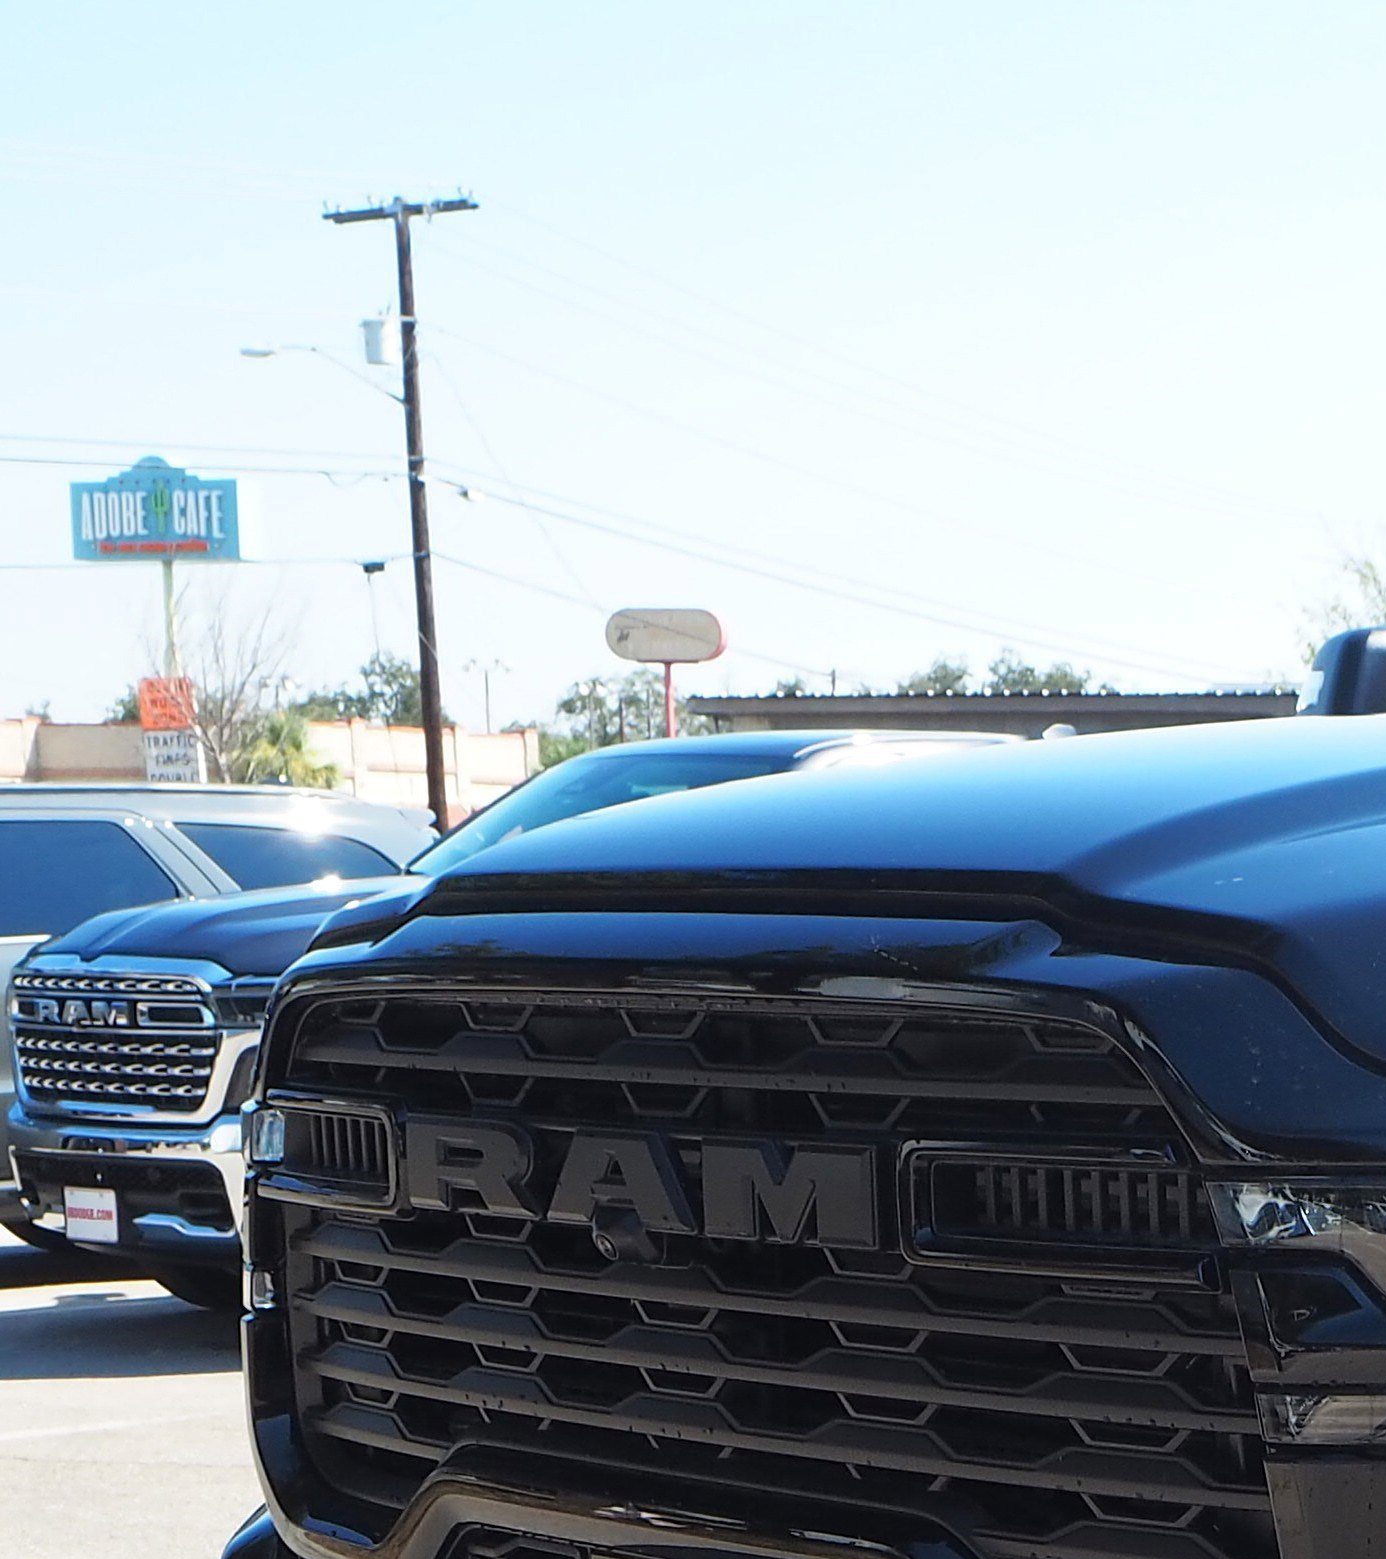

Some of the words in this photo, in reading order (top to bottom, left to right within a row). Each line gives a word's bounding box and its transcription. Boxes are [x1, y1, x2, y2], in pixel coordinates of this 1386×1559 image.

[81, 490, 149, 541] ADOBE
[172, 488, 226, 540] CAFE
[146, 734, 197, 748] TRAFFIC
[37, 1000, 130, 1025] RAM
[404, 1113, 878, 1250] RAM
